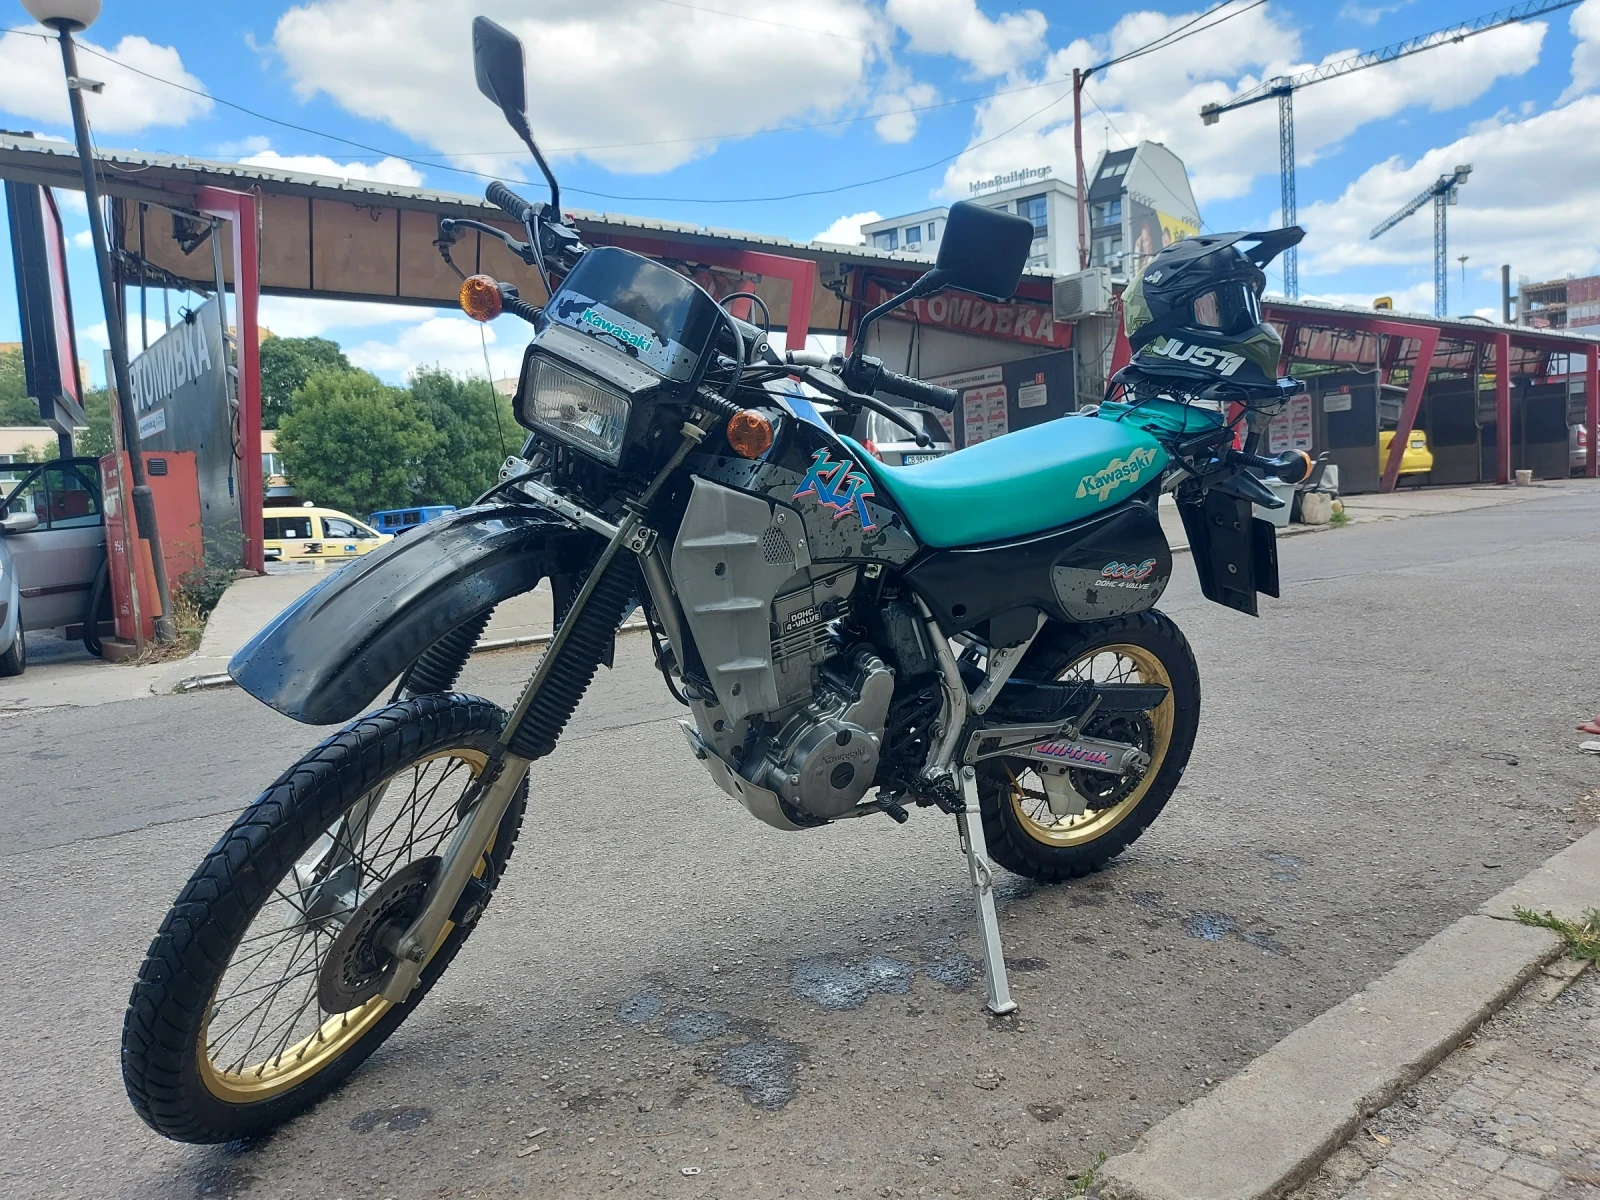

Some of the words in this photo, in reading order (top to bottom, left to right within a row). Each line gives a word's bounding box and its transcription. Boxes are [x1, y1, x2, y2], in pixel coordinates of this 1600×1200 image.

[969, 165, 1052, 193] IdeaBuildings
[582, 307, 654, 353] Kawasaki
[128, 314, 212, 415] ВТОМИВКА
[1153, 338, 1246, 376] JUST1
[792, 447, 877, 532] KLR
[1082, 453, 1150, 494] Kawasaki
[1095, 579, 1117, 588] DOHC
[787, 613, 820, 630] 4-VALVE
[791, 608, 814, 622] DOHC
[822, 746, 865, 764] Kawasaki
